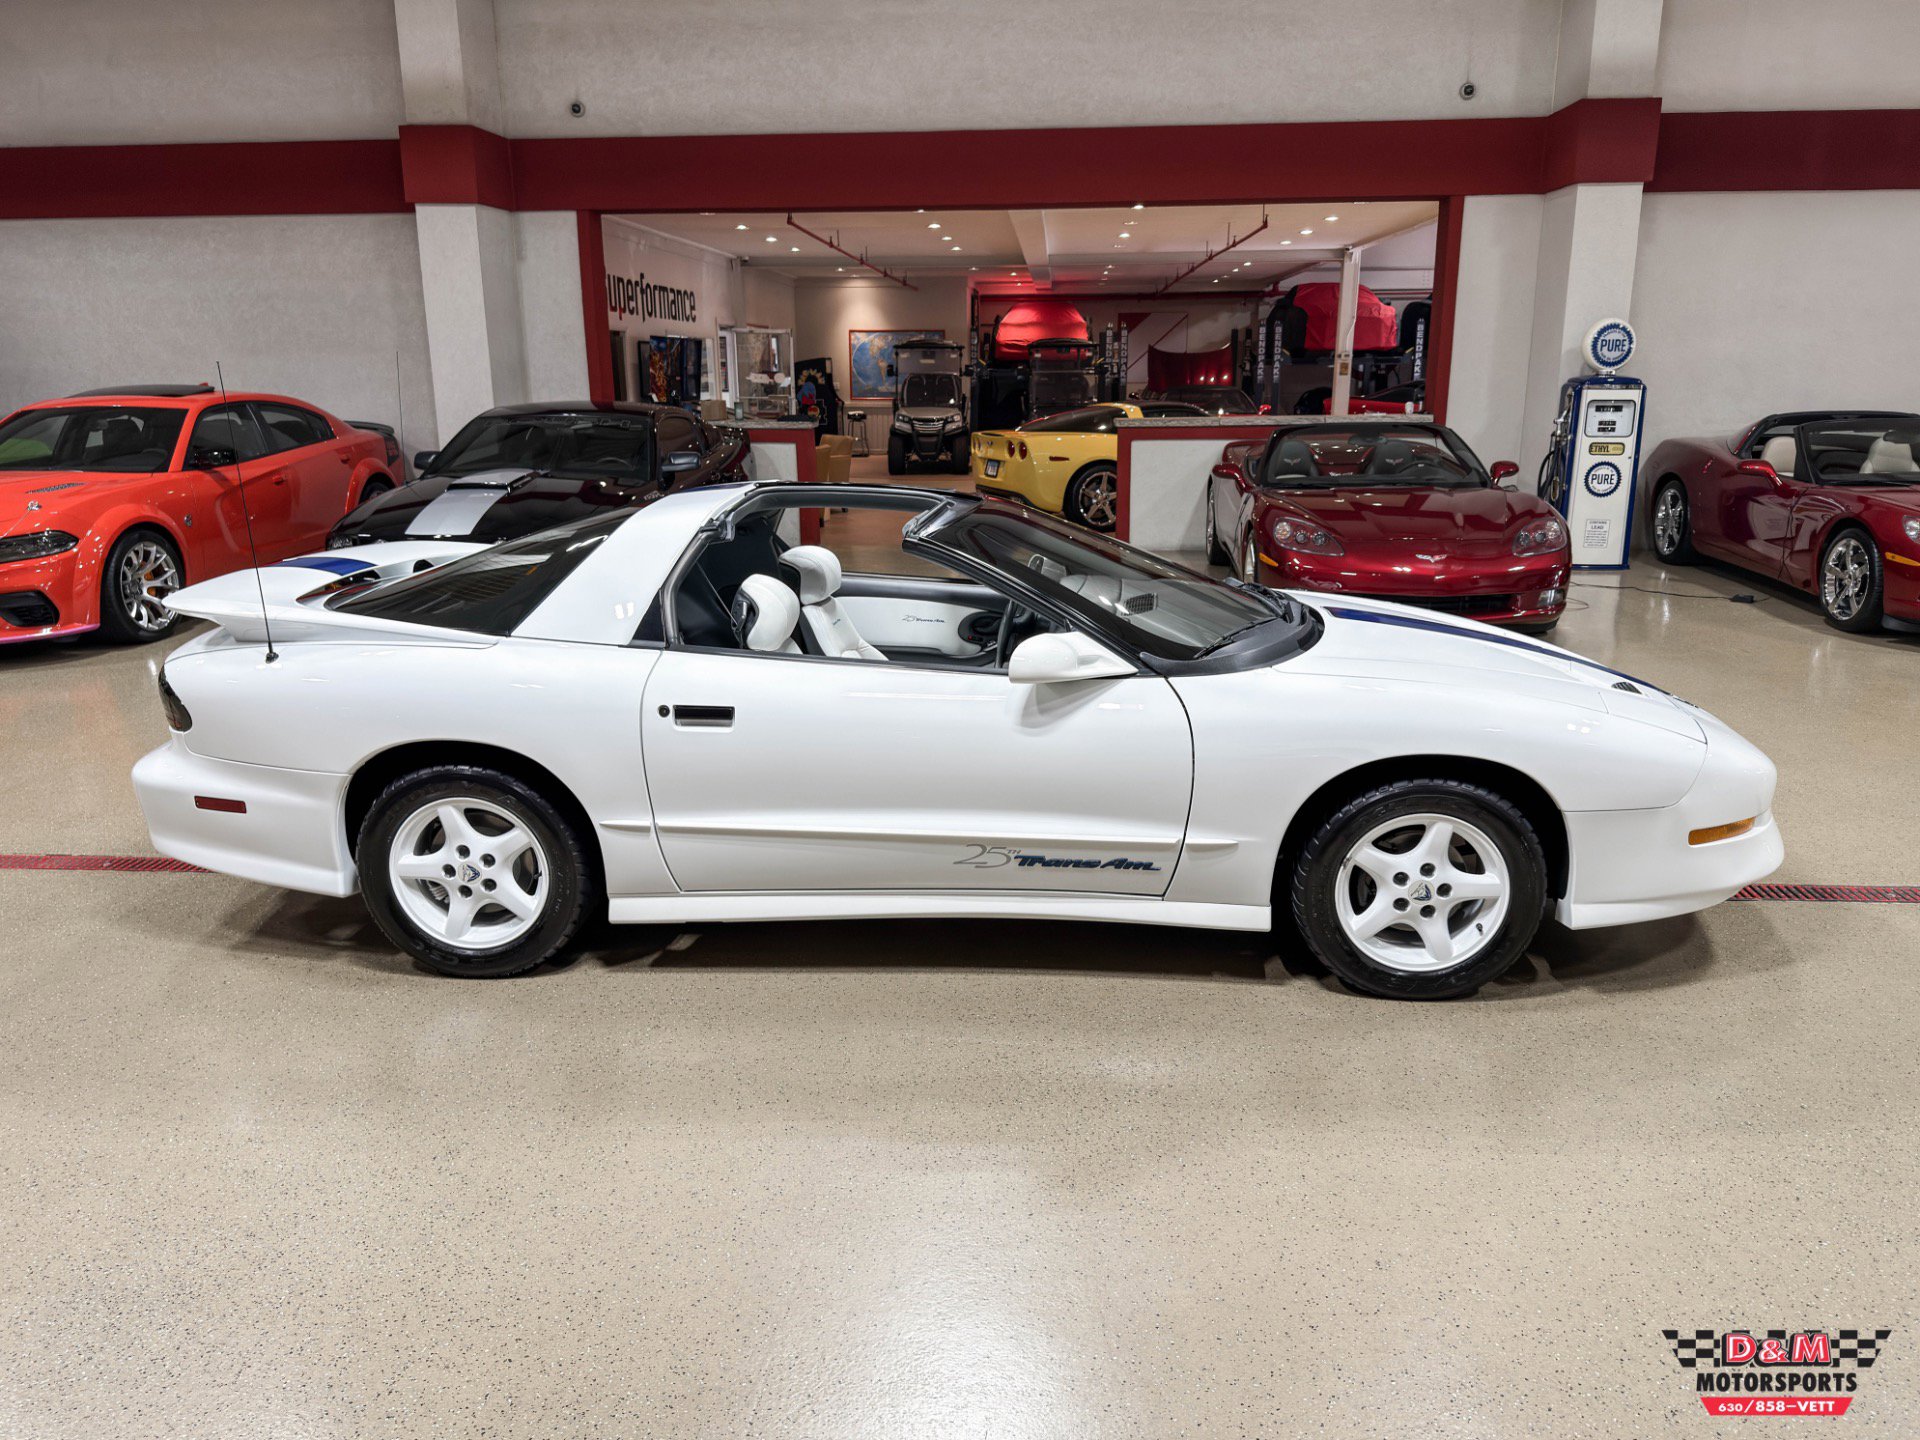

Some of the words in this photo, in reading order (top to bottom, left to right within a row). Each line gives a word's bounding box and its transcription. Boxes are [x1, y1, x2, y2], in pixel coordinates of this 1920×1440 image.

[607, 272, 696, 323] uperformance
[1120, 329, 1128, 379] BENDPAK
[1257, 326, 1266, 375] BENDPAK
[1273, 326, 1282, 375] BENDPAK
[1414, 323, 1425, 373] BENDPAK
[1600, 338, 1627, 352] PURE
[1590, 445, 1609, 453] ETHYL
[1590, 473, 1615, 485] PURE
[1014, 854, 1101, 868] Trans
[1100, 857, 1161, 871] Am
